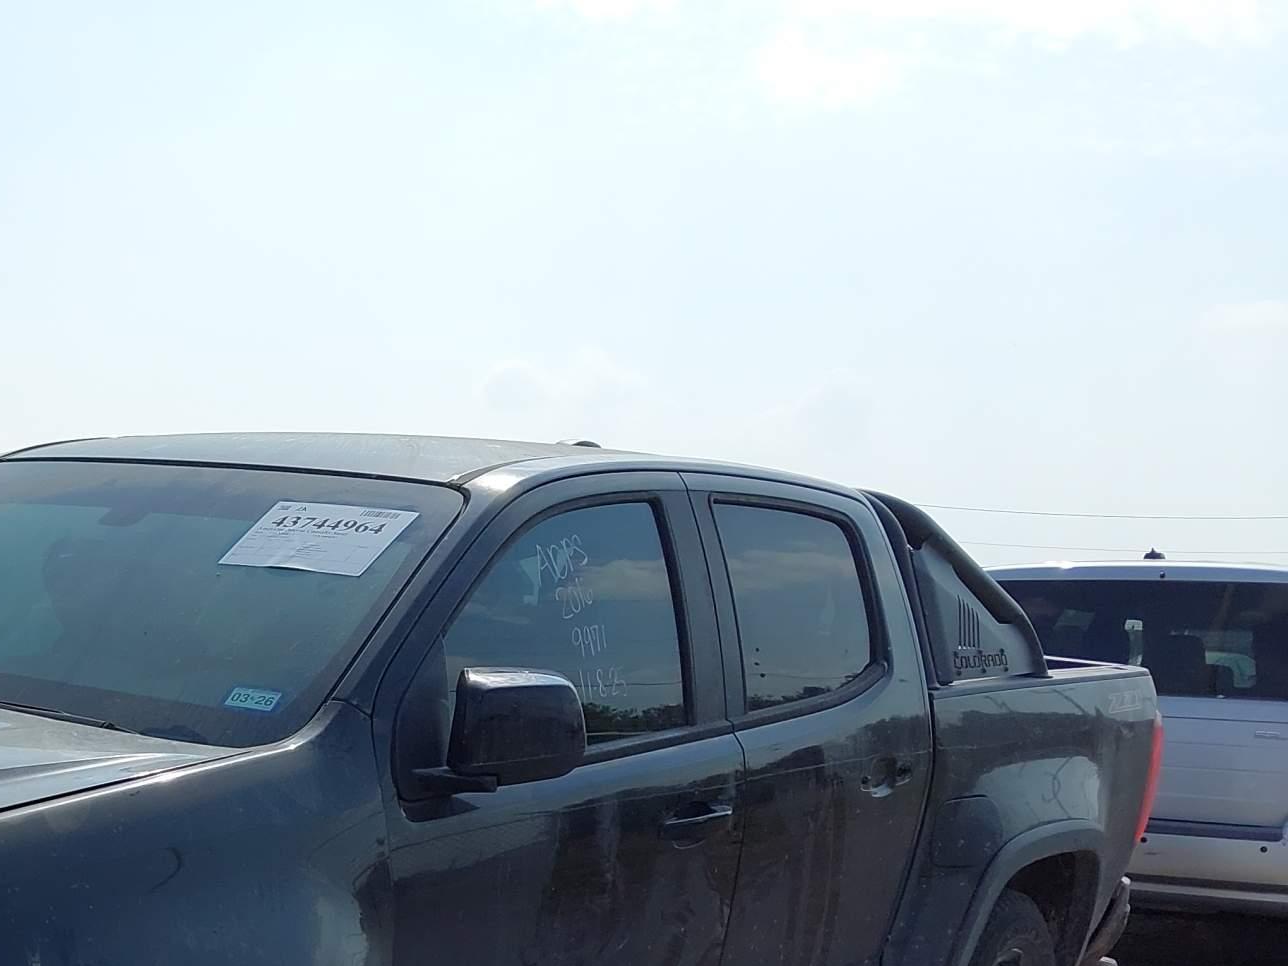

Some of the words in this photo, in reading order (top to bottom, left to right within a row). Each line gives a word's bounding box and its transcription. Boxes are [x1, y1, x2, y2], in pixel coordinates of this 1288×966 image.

[272, 516, 387, 535] 43744964
[572, 624, 607, 657] 9971
[953, 653, 1009, 670] COLORADO
